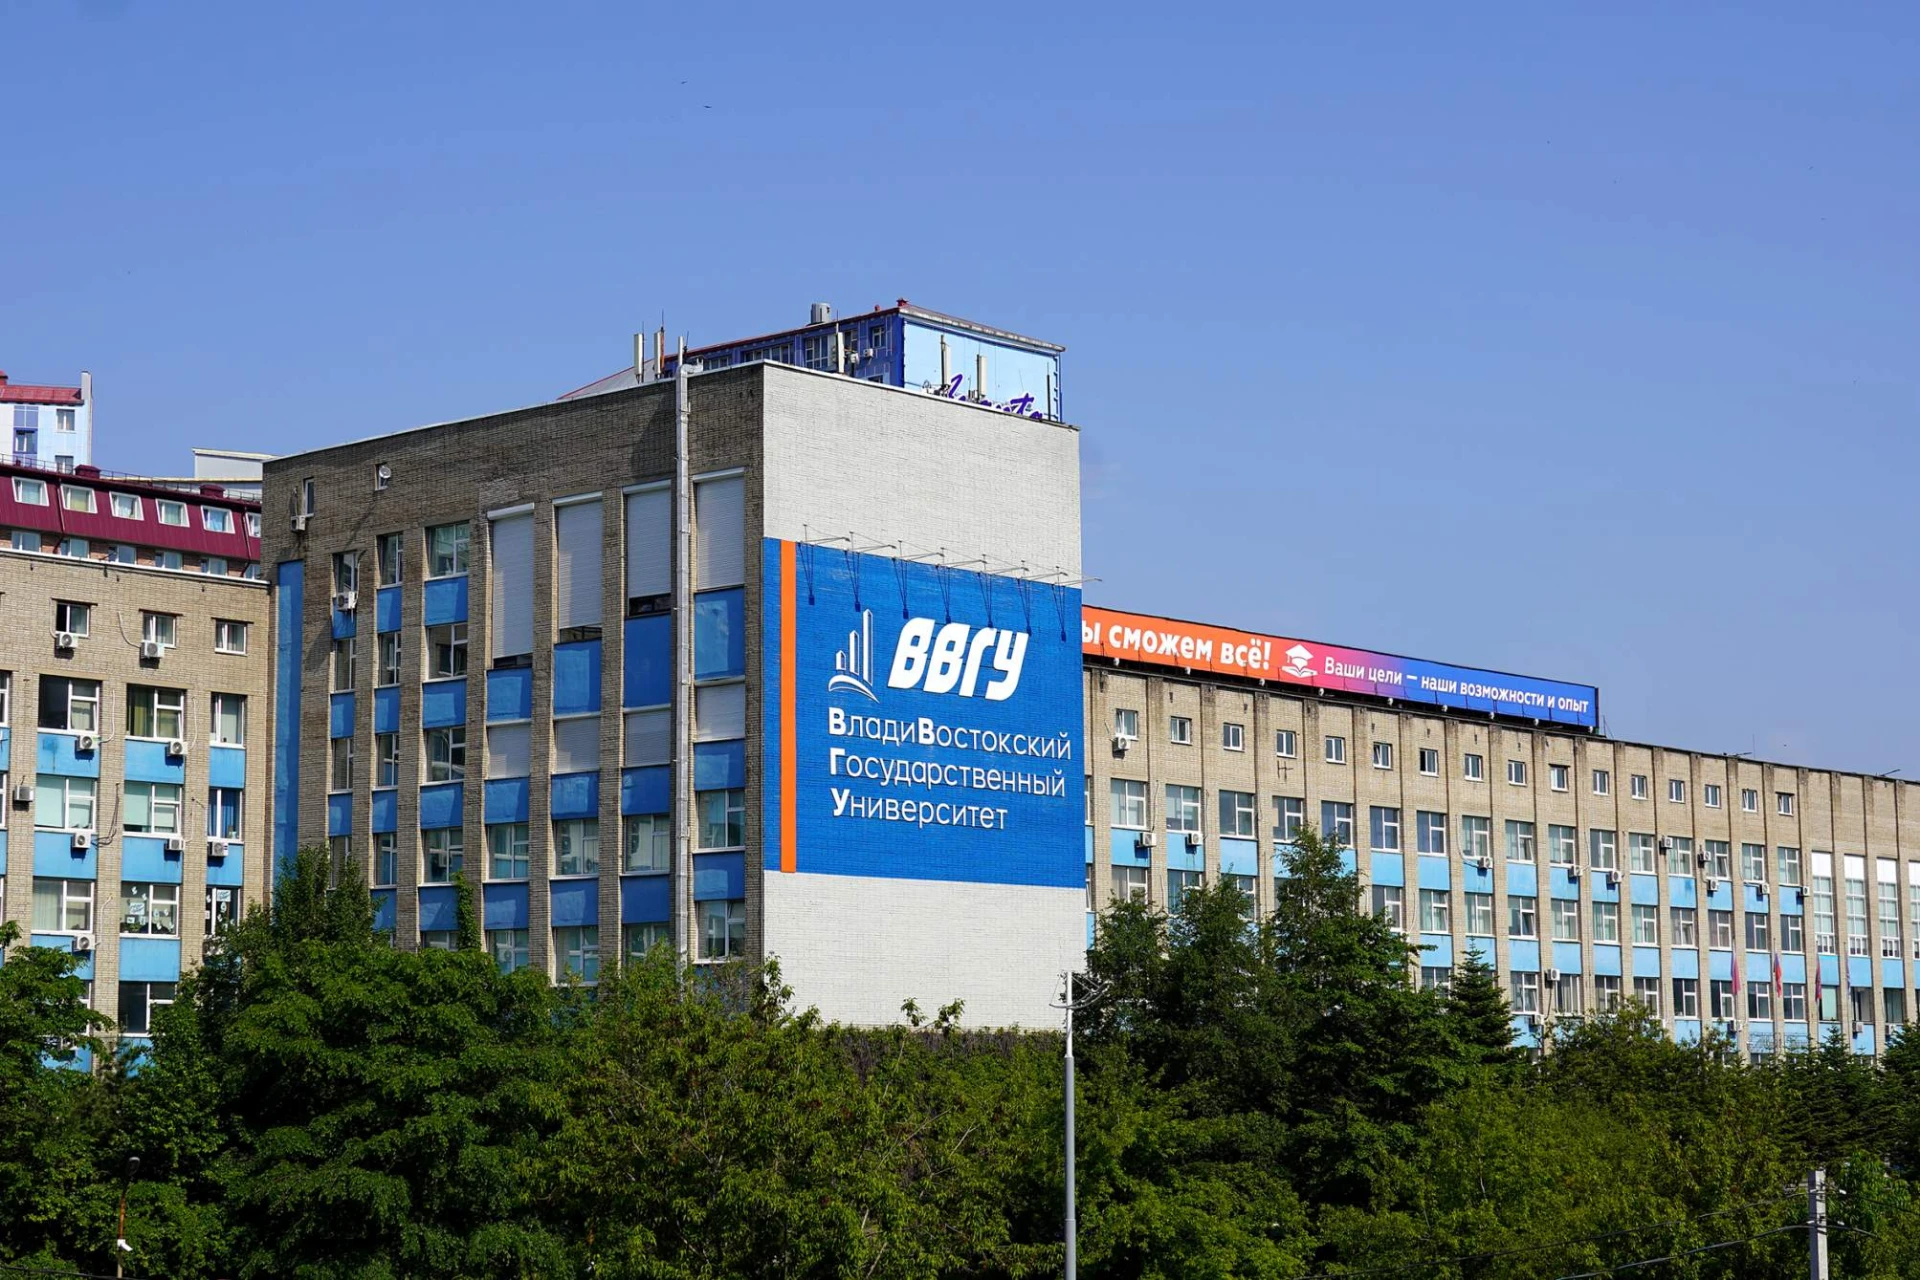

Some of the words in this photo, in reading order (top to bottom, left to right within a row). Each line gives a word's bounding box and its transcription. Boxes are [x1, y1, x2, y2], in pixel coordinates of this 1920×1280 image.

[887, 616, 1029, 701] ВВГУ
[1081, 619, 1101, 645] ы
[1108, 624, 1213, 662] сможем
[1220, 638, 1272, 670] всё!
[1324, 656, 1365, 680] Ваши
[1368, 667, 1403, 685] цели
[1421, 676, 1457, 694] наши
[1460, 682, 1545, 707] возможности
[1547, 695, 1555, 709] и
[1557, 697, 1589, 713] опыт
[828, 706, 1072, 760] ВладиВостокский
[829, 747, 1066, 798] Государственный
[831, 787, 1009, 830] Университет
